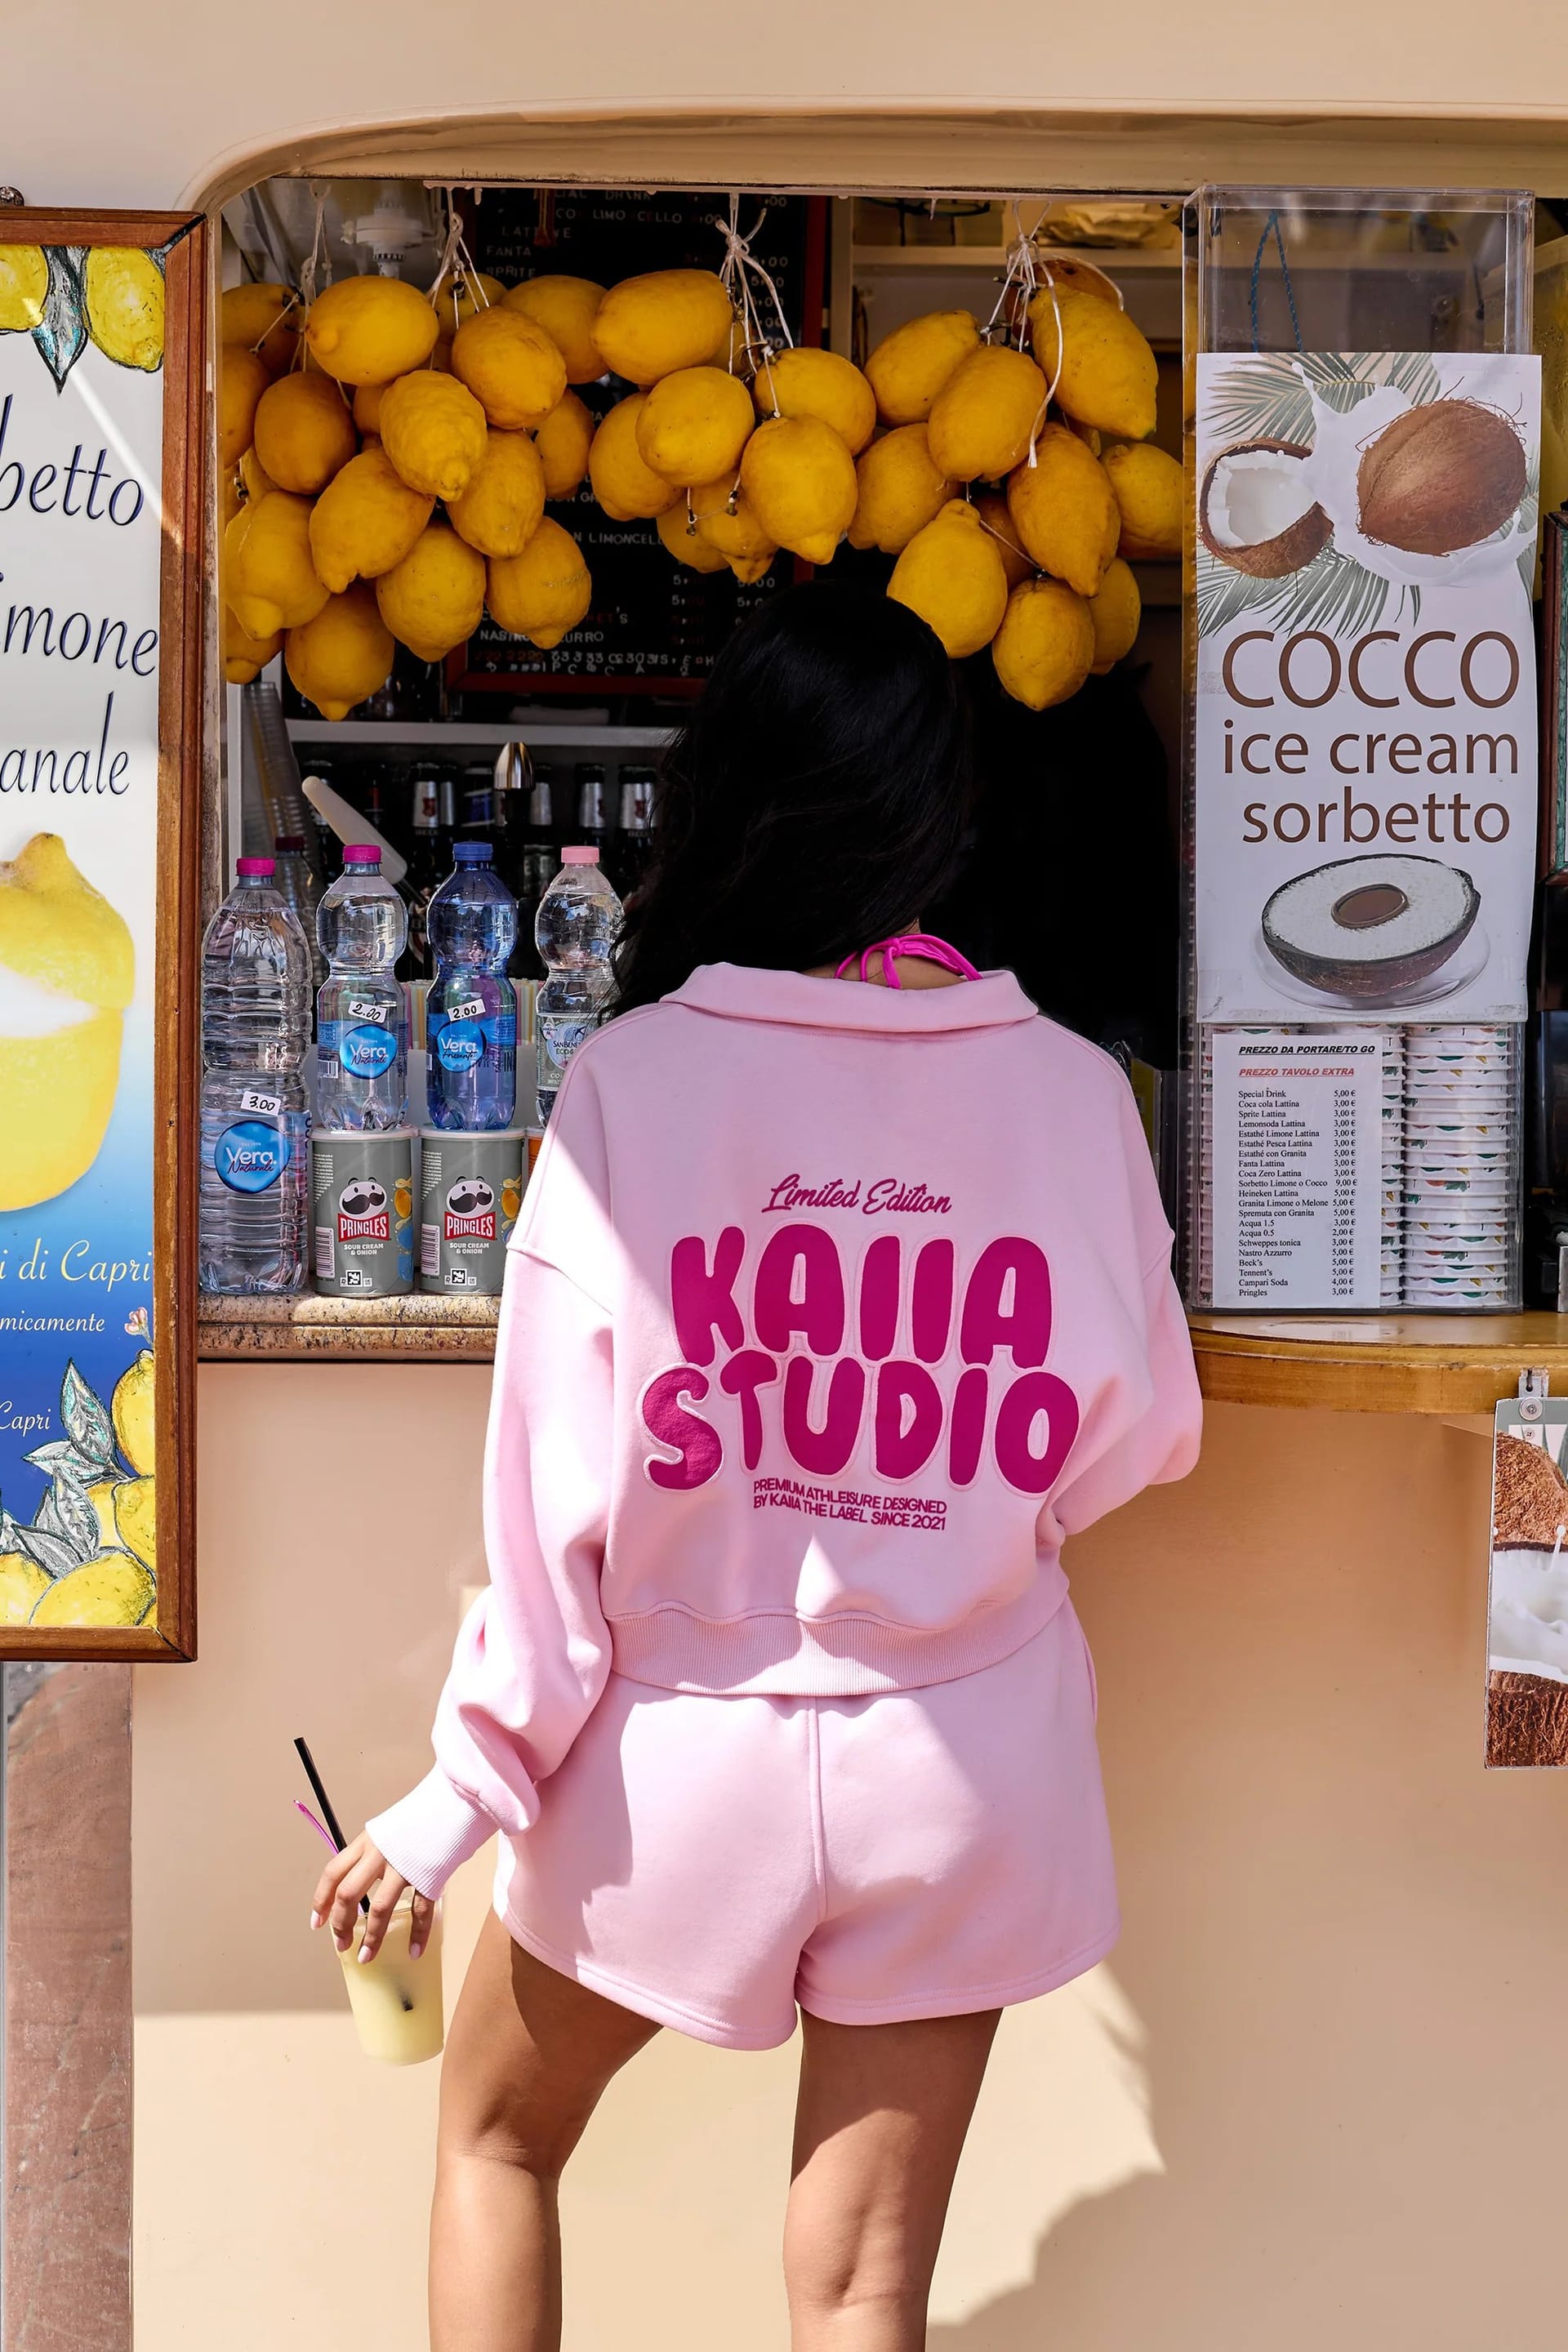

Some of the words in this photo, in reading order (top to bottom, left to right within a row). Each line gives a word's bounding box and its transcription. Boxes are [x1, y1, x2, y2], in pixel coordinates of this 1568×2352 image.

[486, 246, 532, 257] FANTA
[0, 573, 158, 676] mone
[1223, 630, 1520, 709] COCCO
[0, 691, 130, 795] anale
[1224, 719, 1309, 774] ice
[1330, 733, 1518, 774] cream
[1242, 786, 1511, 843] sorbetto
[352, 1003, 381, 1021] 2.00
[452, 1004, 477, 1019] 2.00
[441, 1037, 477, 1053] Vera
[1296, 1045, 1357, 1054] PORTARE/TO
[1361, 1045, 1375, 1054] GO
[350, 1044, 386, 1058] Vera
[1321, 1067, 1355, 1076] EXTRA
[1238, 1090, 1264, 1100] Special
[1334, 1089, 1350, 1098] 5,00
[249, 1095, 275, 1111] 3.00
[1334, 1099, 1350, 1107] 3,00
[1238, 1110, 1260, 1120] Sprite
[1334, 1109, 1350, 1118] 3,00
[1334, 1119, 1350, 1128] 3,00
[1334, 1129, 1350, 1138] 3,00
[1334, 1139, 1350, 1147] 3,00
[225, 1147, 274, 1165] Vera
[1334, 1149, 1350, 1157] 5,00
[1334, 1159, 1350, 1167] 3,00
[1334, 1169, 1350, 1177] 3,00
[1335, 1178, 1352, 1187] 9,00
[761, 1174, 862, 1214] Limited
[862, 1178, 952, 1214] Edition
[1334, 1188, 1351, 1196] 5,00
[1333, 1198, 1348, 1206] 5,00
[1238, 1209, 1273, 1218] Spremuta
[1334, 1208, 1350, 1216] 5,00
[340, 1216, 387, 1238] PRINGLES
[447, 1216, 493, 1236] PRINGLES
[1238, 1218, 1262, 1228] Acqua
[1334, 1218, 1350, 1226] 3,00
[1238, 1228, 1262, 1238] Acqua
[1333, 1227, 1349, 1236] 2,00
[1238, 1238, 1279, 1248] Schweppes
[1280, 1238, 1301, 1246] tonica
[1333, 1237, 1348, 1245] 3,00
[1333, 1247, 1349, 1256] 5,00
[19, 1237, 48, 1281] di
[60, 1240, 153, 1293] Capri
[1332, 1257, 1348, 1266] 5,00
[1333, 1267, 1348, 1276] 5,00
[1238, 1278, 1269, 1287] Campari
[1331, 1277, 1348, 1285] 4,00
[670, 1223, 1053, 1370] KAIIA
[1239, 1288, 1268, 1297] Pringles
[1332, 1287, 1348, 1295] 3,00
[0, 1310, 105, 1332] micamente
[642, 1349, 1080, 1494] STUDIO
[754, 1477, 805, 1497] PREMIUM
[806, 1487, 882, 1509] ATHLEISURE
[883, 1497, 947, 1514] DESIGNED
[754, 1494, 768, 1508] BY
[769, 1493, 802, 1511] KAIIA
[803, 1500, 827, 1517] THE
[829, 1505, 867, 1523] LABEL
[871, 1511, 910, 1527] SINCE
[911, 1515, 947, 1530] 2021
